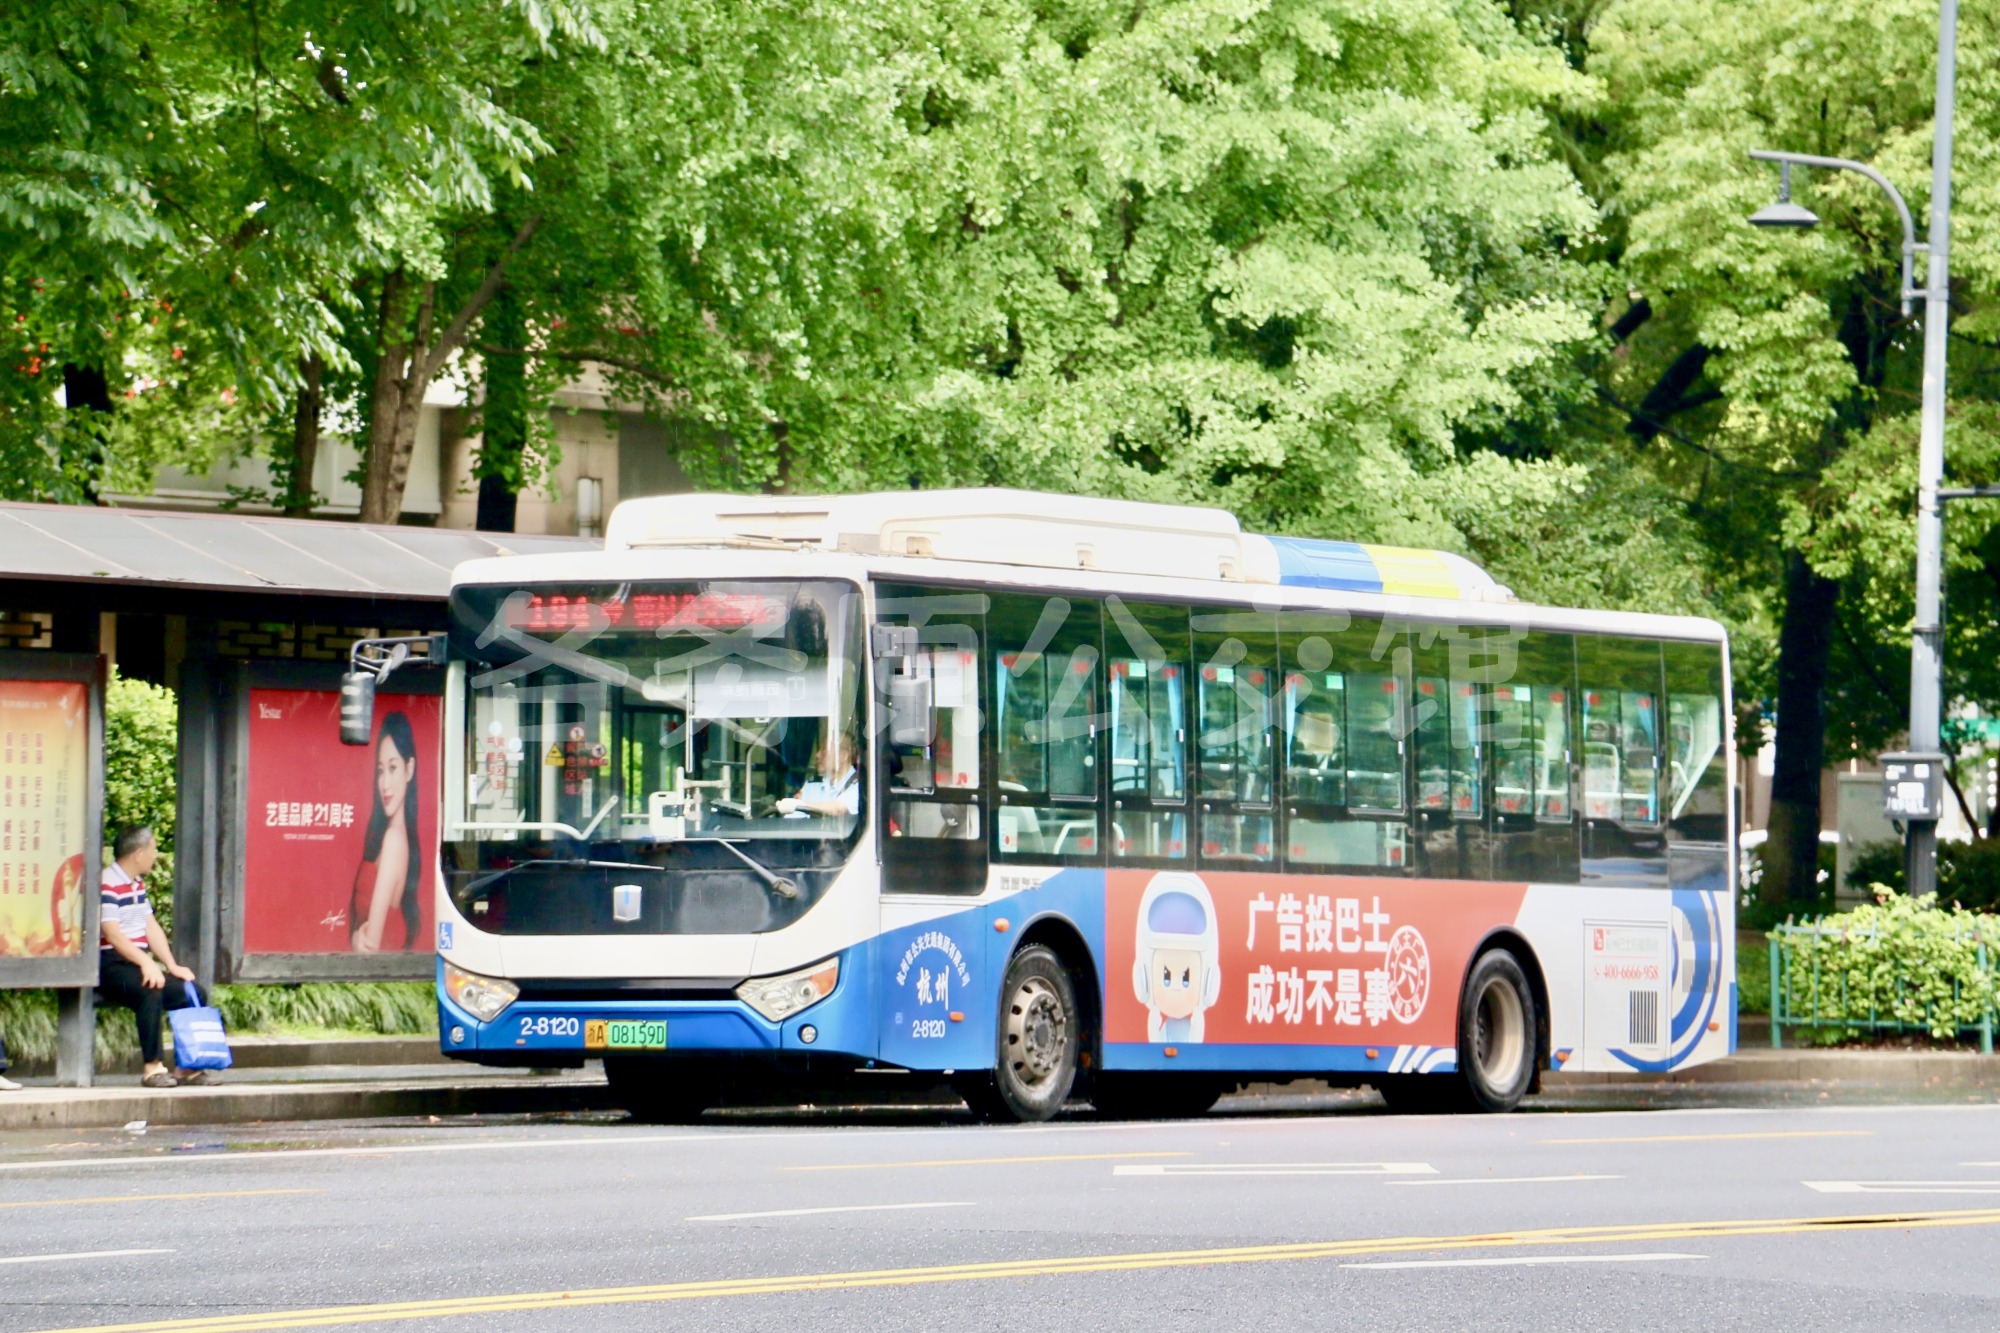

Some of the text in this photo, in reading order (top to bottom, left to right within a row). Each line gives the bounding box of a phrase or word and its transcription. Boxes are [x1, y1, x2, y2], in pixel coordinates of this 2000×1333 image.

[266, 801, 354, 828] 艺星品牌21周年
[1246, 892, 1390, 953] 广告投巴士
[916, 965, 949, 1011] 杭州
[1246, 964, 1390, 1027] 成功不是事
[520, 1017, 579, 1036] 2-8120
[612, 1025, 664, 1044] 08159D
[912, 1019, 945, 1038] 2-8120
